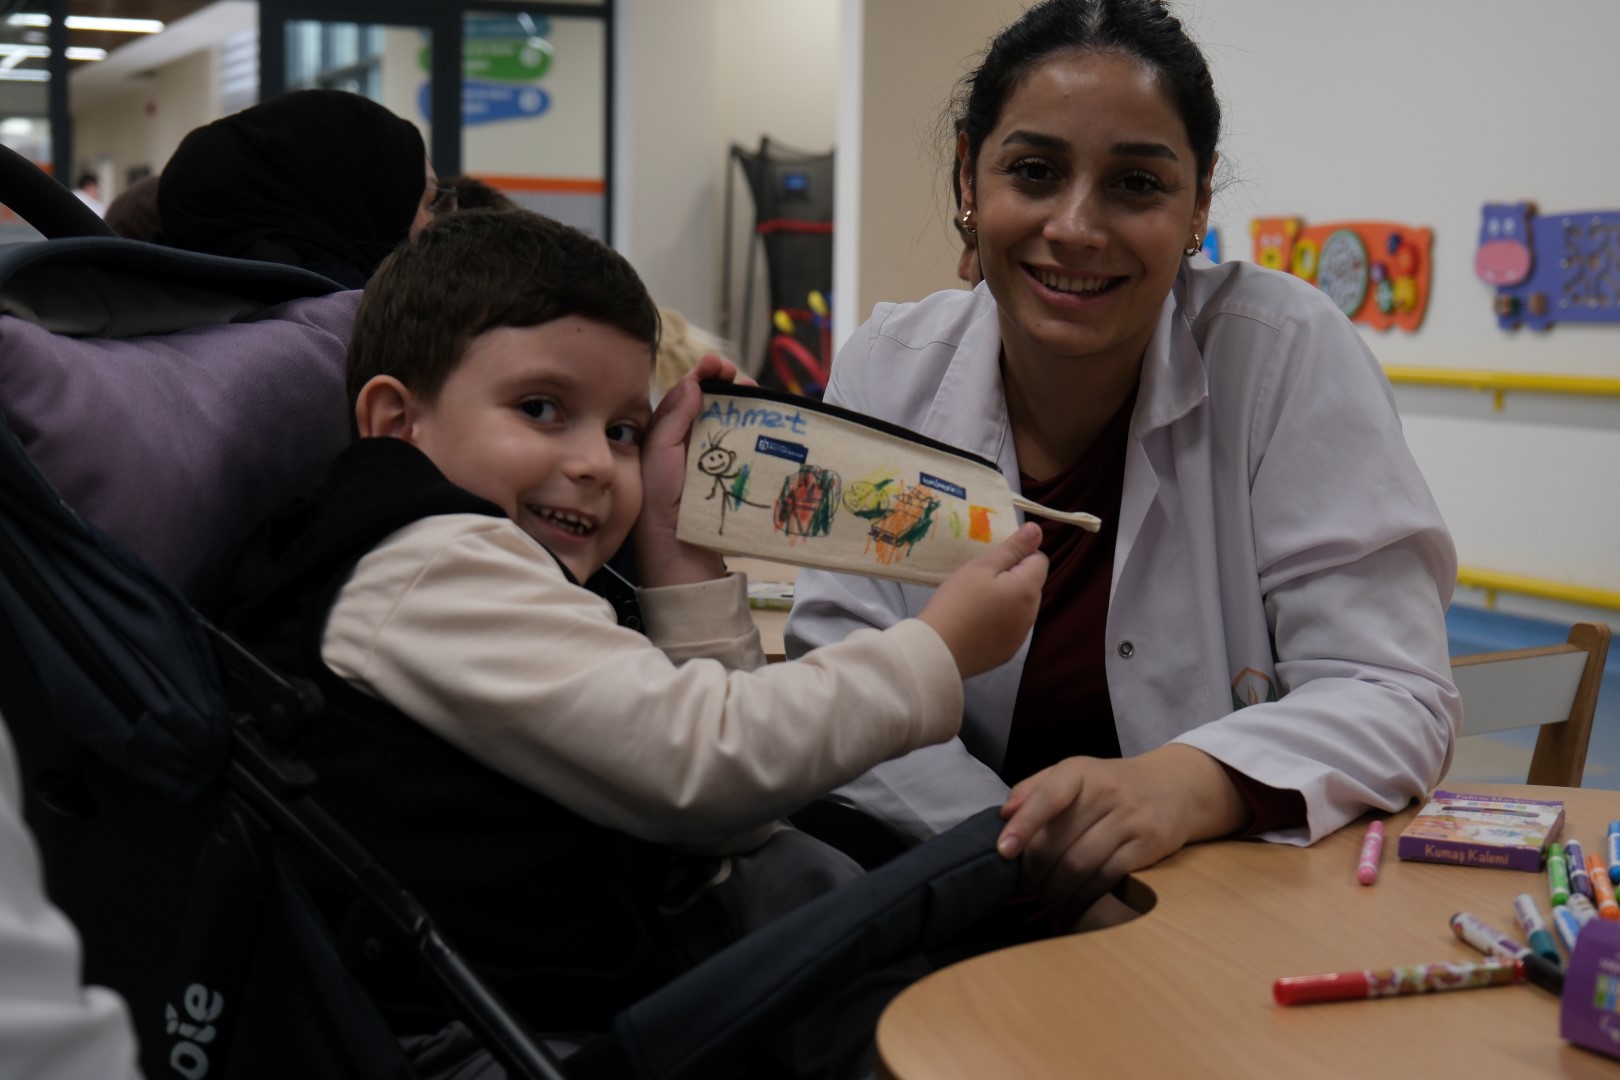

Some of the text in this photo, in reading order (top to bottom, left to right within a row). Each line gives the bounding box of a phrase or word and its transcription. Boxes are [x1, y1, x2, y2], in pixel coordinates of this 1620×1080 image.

[700, 399, 807, 435] Ahmet
[1424, 843, 1509, 865] Kumaş Kalemi
